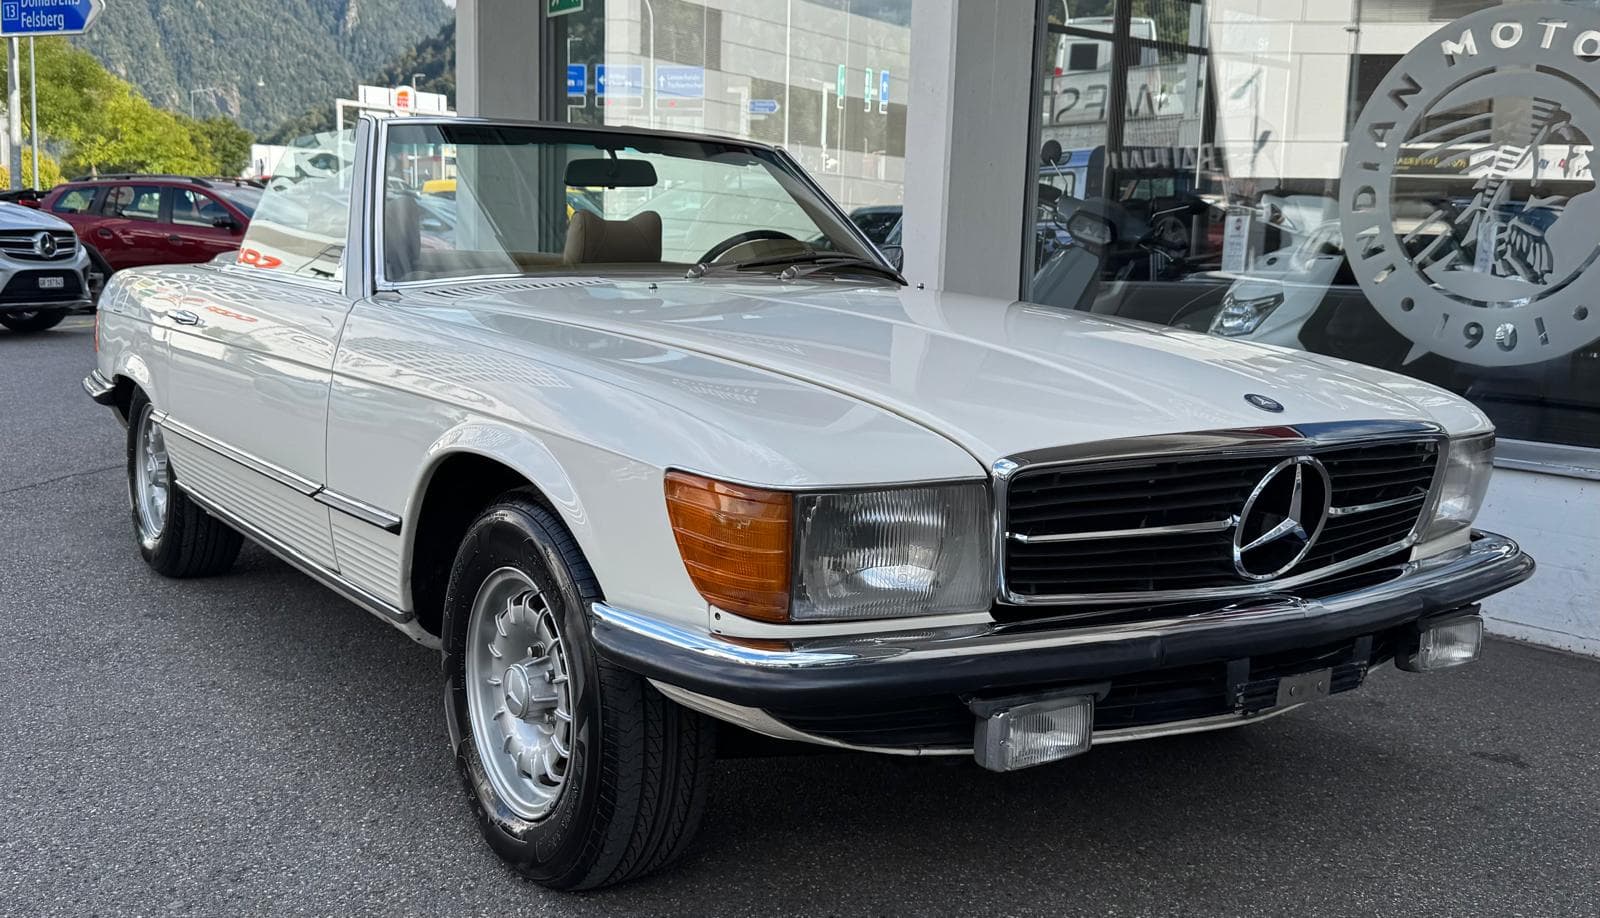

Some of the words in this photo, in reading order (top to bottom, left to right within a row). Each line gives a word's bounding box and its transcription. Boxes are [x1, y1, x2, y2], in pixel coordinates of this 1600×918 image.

[6, 5, 16, 18] 13
[21, 10, 64, 30] Felsberg
[1352, 72, 1422, 284] INDIAN
[1433, 313, 1549, 351] 1901
